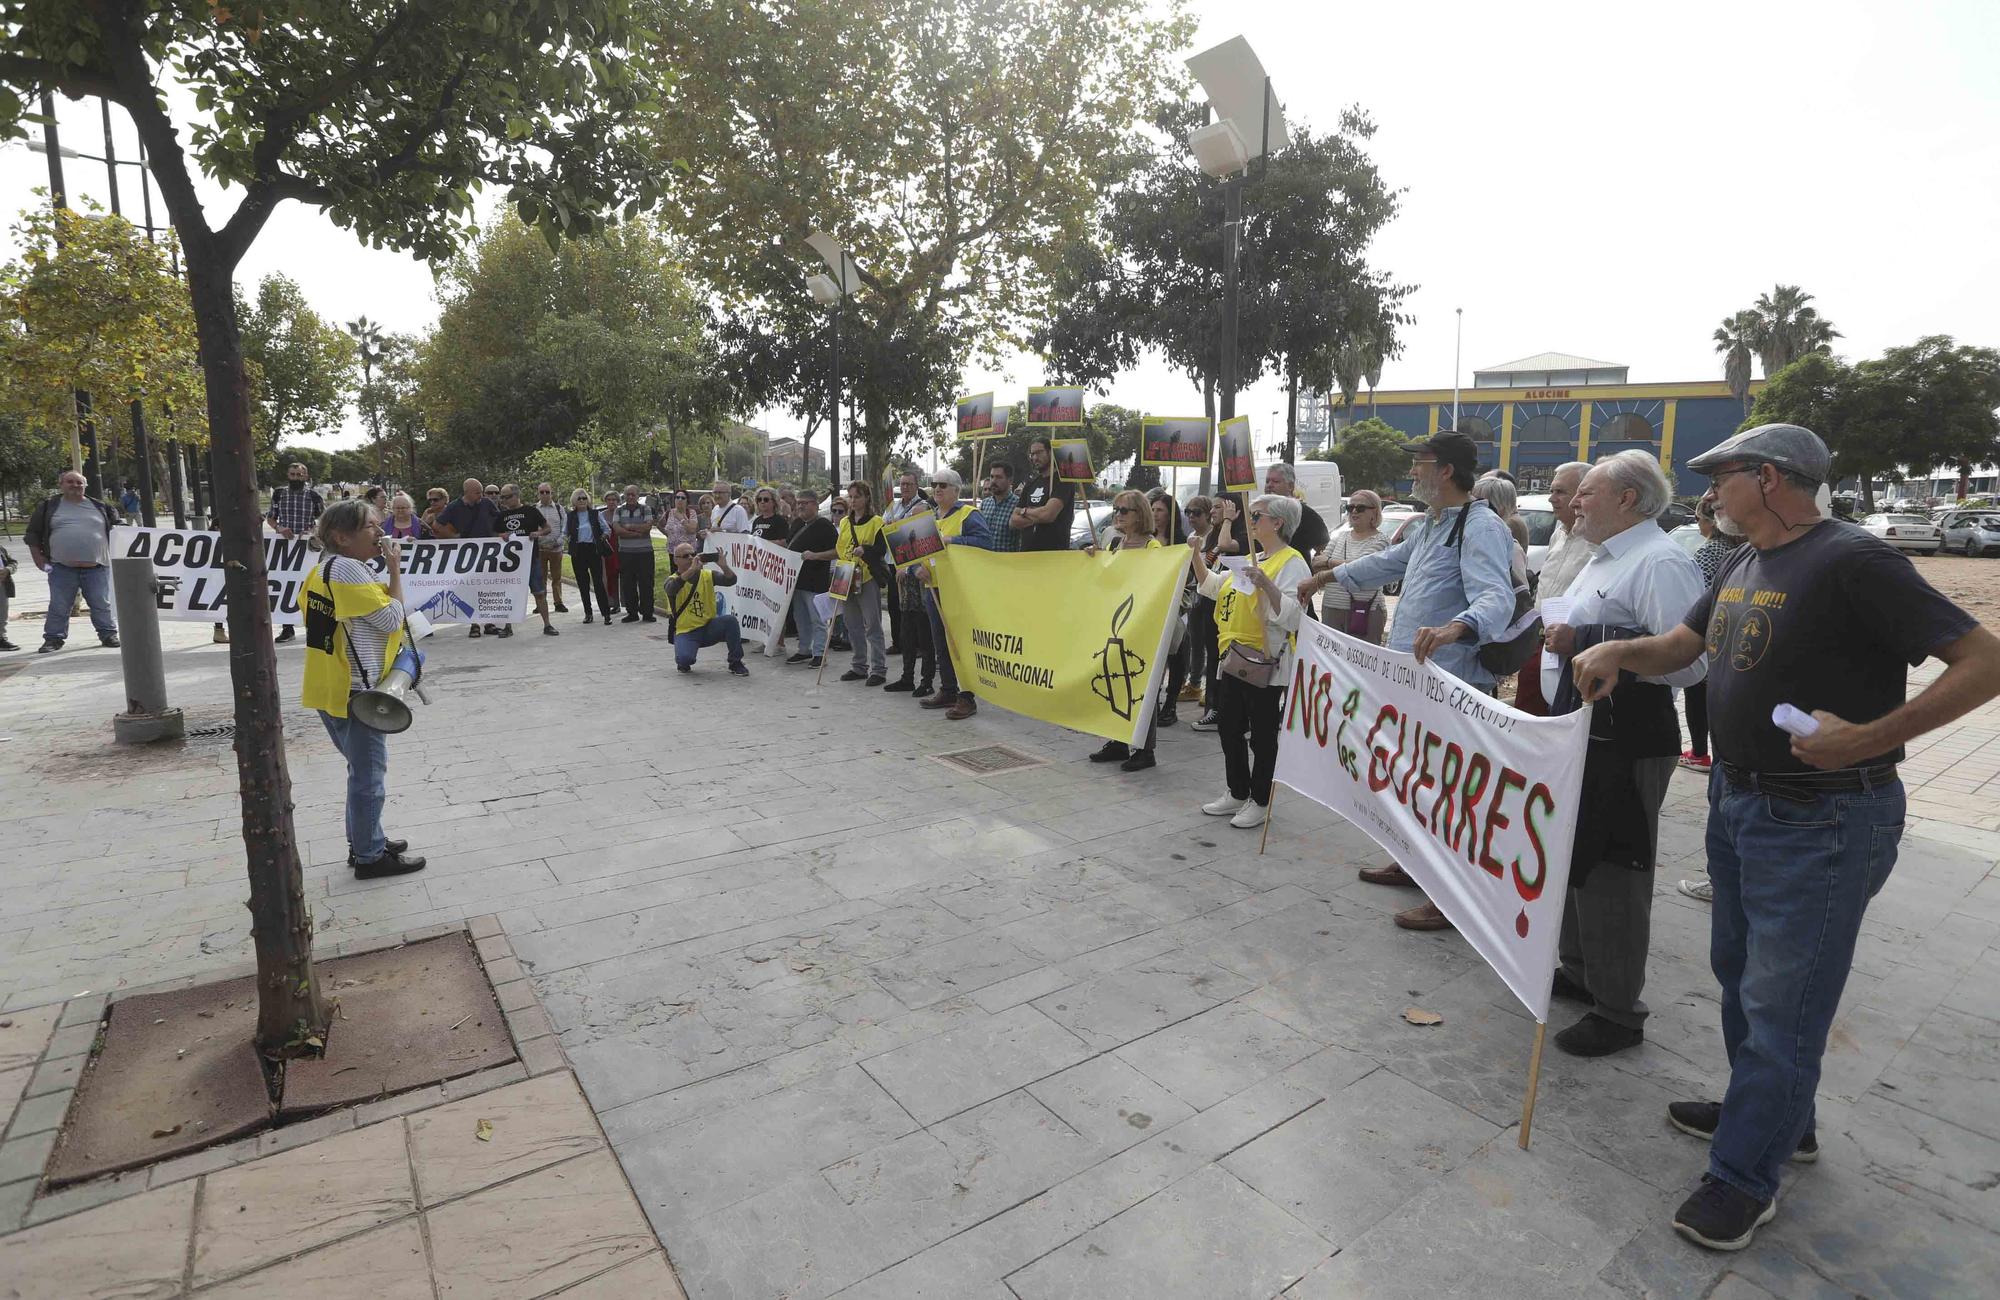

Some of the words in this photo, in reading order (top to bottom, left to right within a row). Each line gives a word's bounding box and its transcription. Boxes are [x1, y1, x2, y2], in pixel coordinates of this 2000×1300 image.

[1525, 390, 1571, 399] ALUCINE
[484, 578, 522, 587] GUERRES
[972, 628, 1023, 655] AMNISTIA
[974, 651, 1054, 690] INTERNACIONAL
[1347, 647, 1379, 672] DISSOLUCIÓ
[1381, 660, 1391, 679] DE
[1393, 663, 1417, 690] L'OTAN
[1426, 675, 1445, 703] DELS
[1286, 658, 1333, 748] NO
[1336, 719, 1360, 782] les
[1366, 703, 1555, 902] GUERRES
